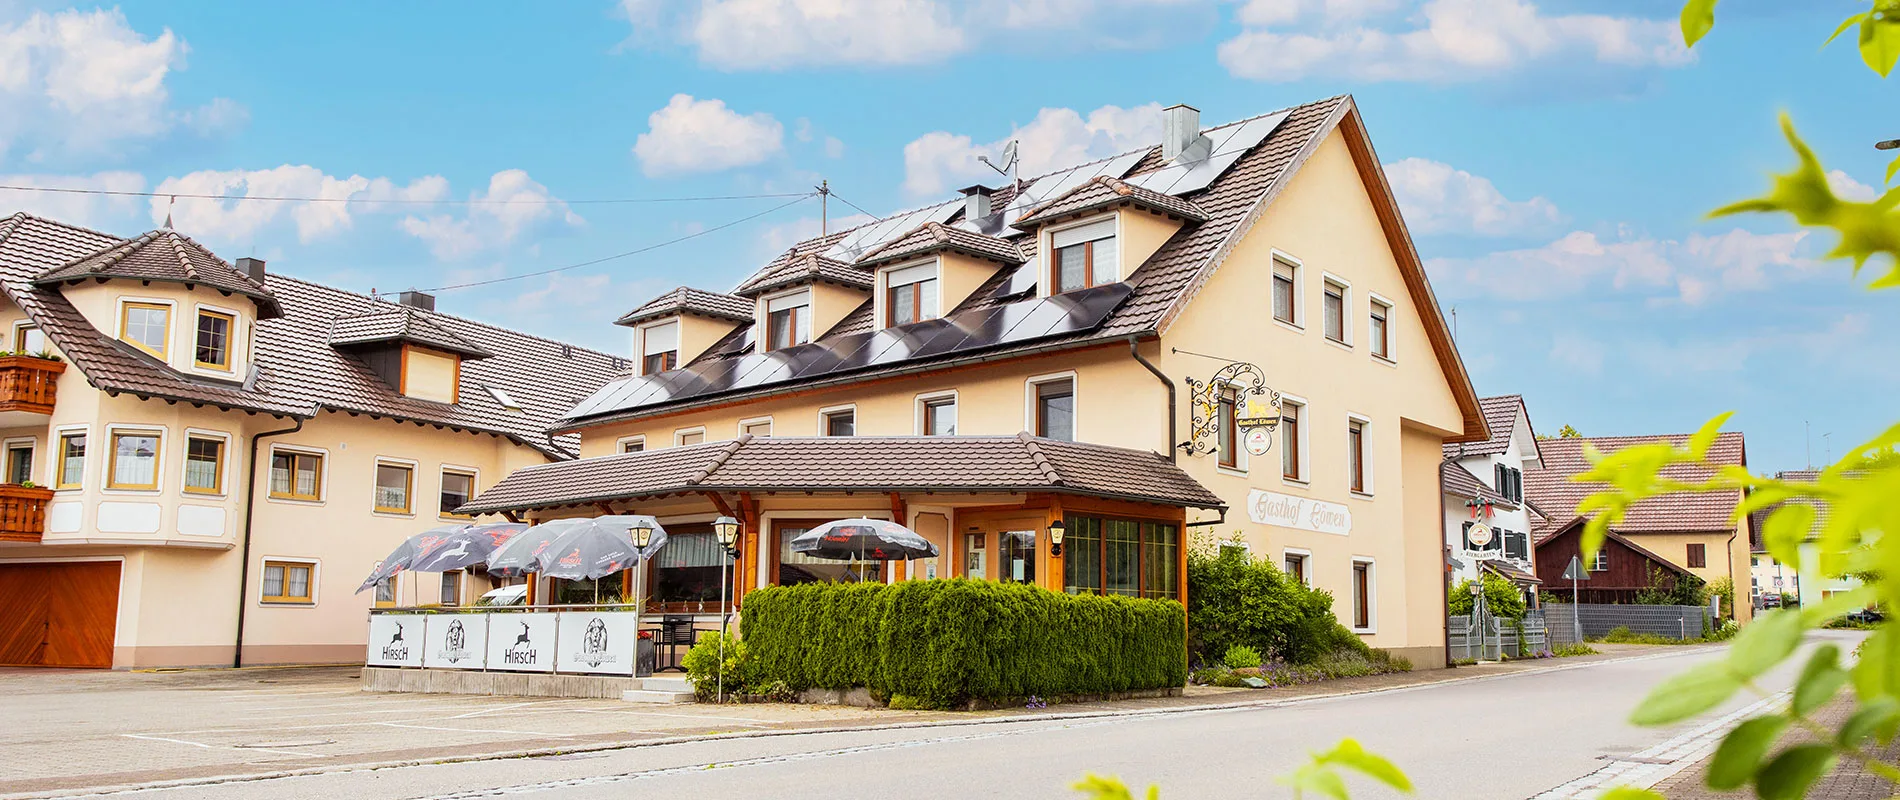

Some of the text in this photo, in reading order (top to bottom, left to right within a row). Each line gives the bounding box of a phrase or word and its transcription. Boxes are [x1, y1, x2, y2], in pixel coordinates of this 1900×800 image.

[1255, 493, 1345, 529] Gasthof Löwen
[382, 646, 409, 661] HIRSCH
[504, 648, 537, 665] HIRSCH
